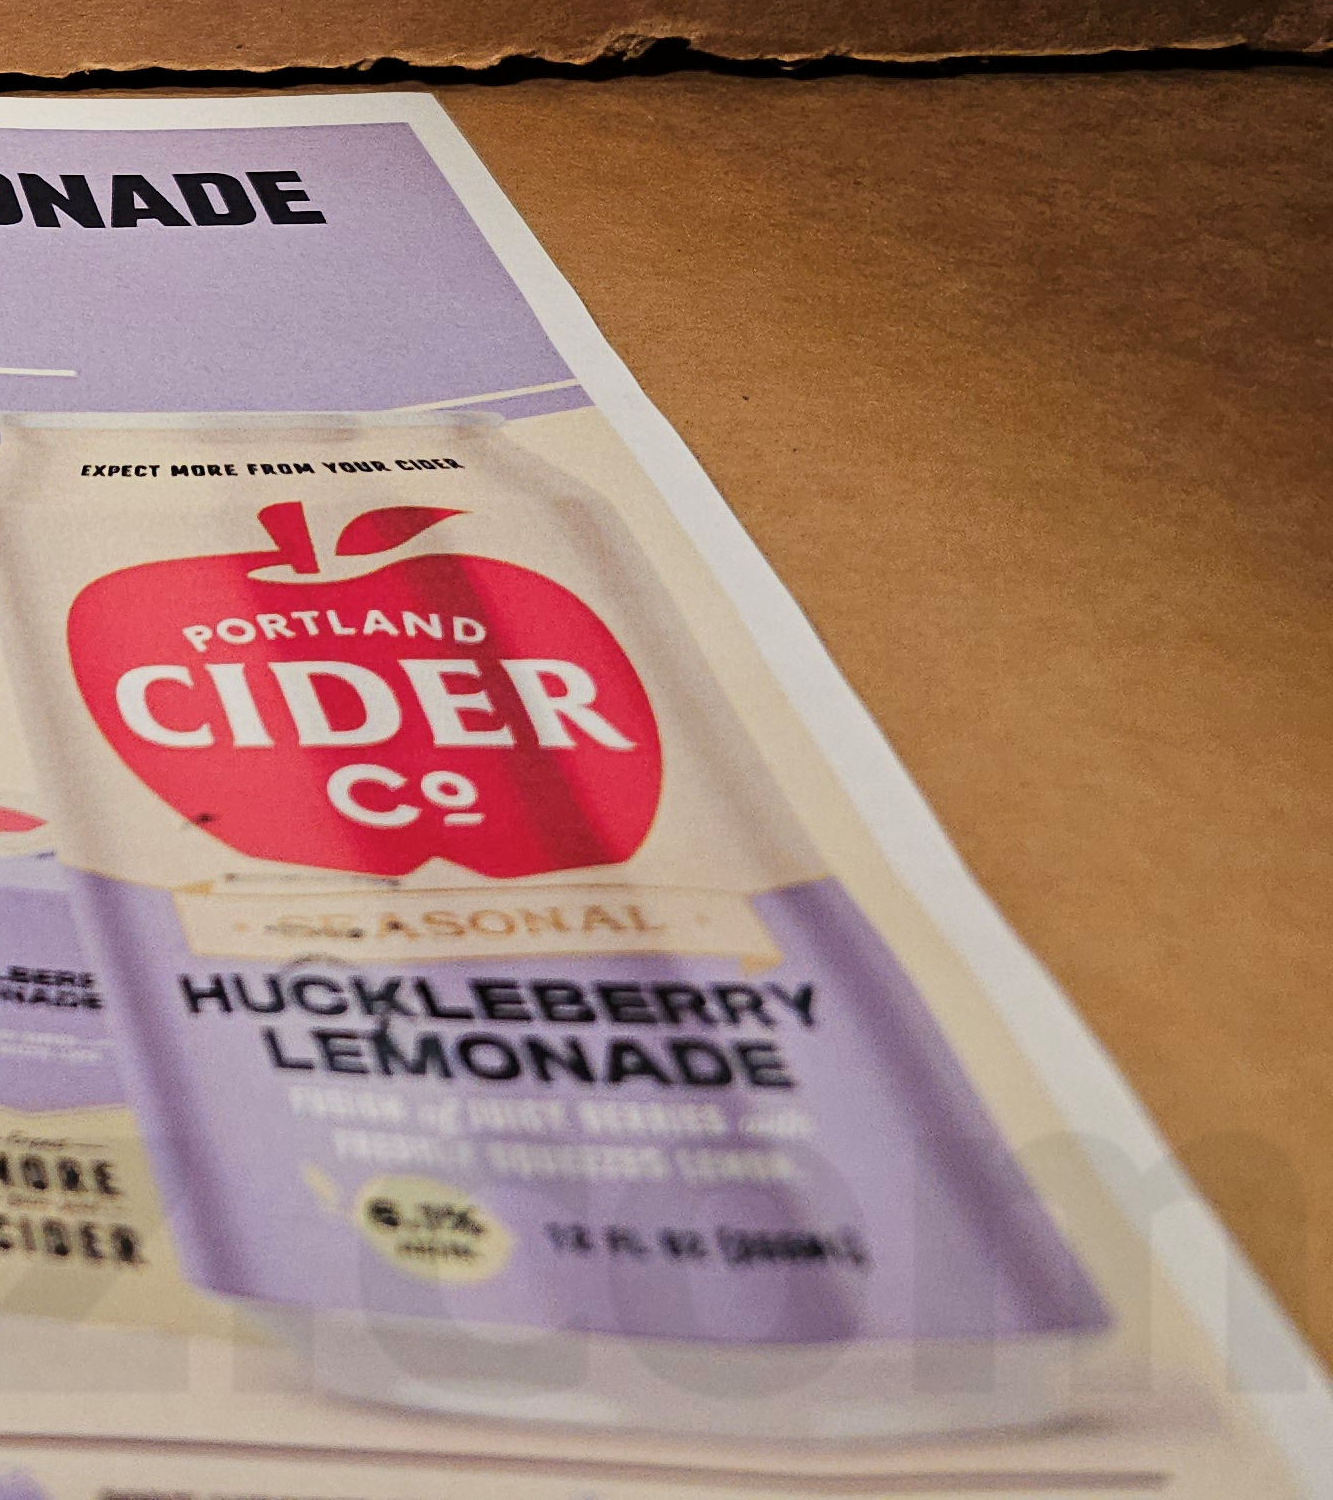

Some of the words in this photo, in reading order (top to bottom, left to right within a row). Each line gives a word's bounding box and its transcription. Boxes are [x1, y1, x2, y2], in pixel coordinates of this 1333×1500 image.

[80, 463, 161, 478] EXPECT
[171, 463, 239, 477] MORE
[247, 461, 316, 476] FROM
[323, 460, 392, 475] YOUR
[396, 457, 465, 472] CIDER
[182, 608, 489, 653] PORTLAND
[114, 656, 637, 751] CIDER
[279, 902, 668, 940] SEASONAL
[180, 970, 820, 1030] HUCKLEBERRY
[263, 1023, 796, 1090] LEMONADE
